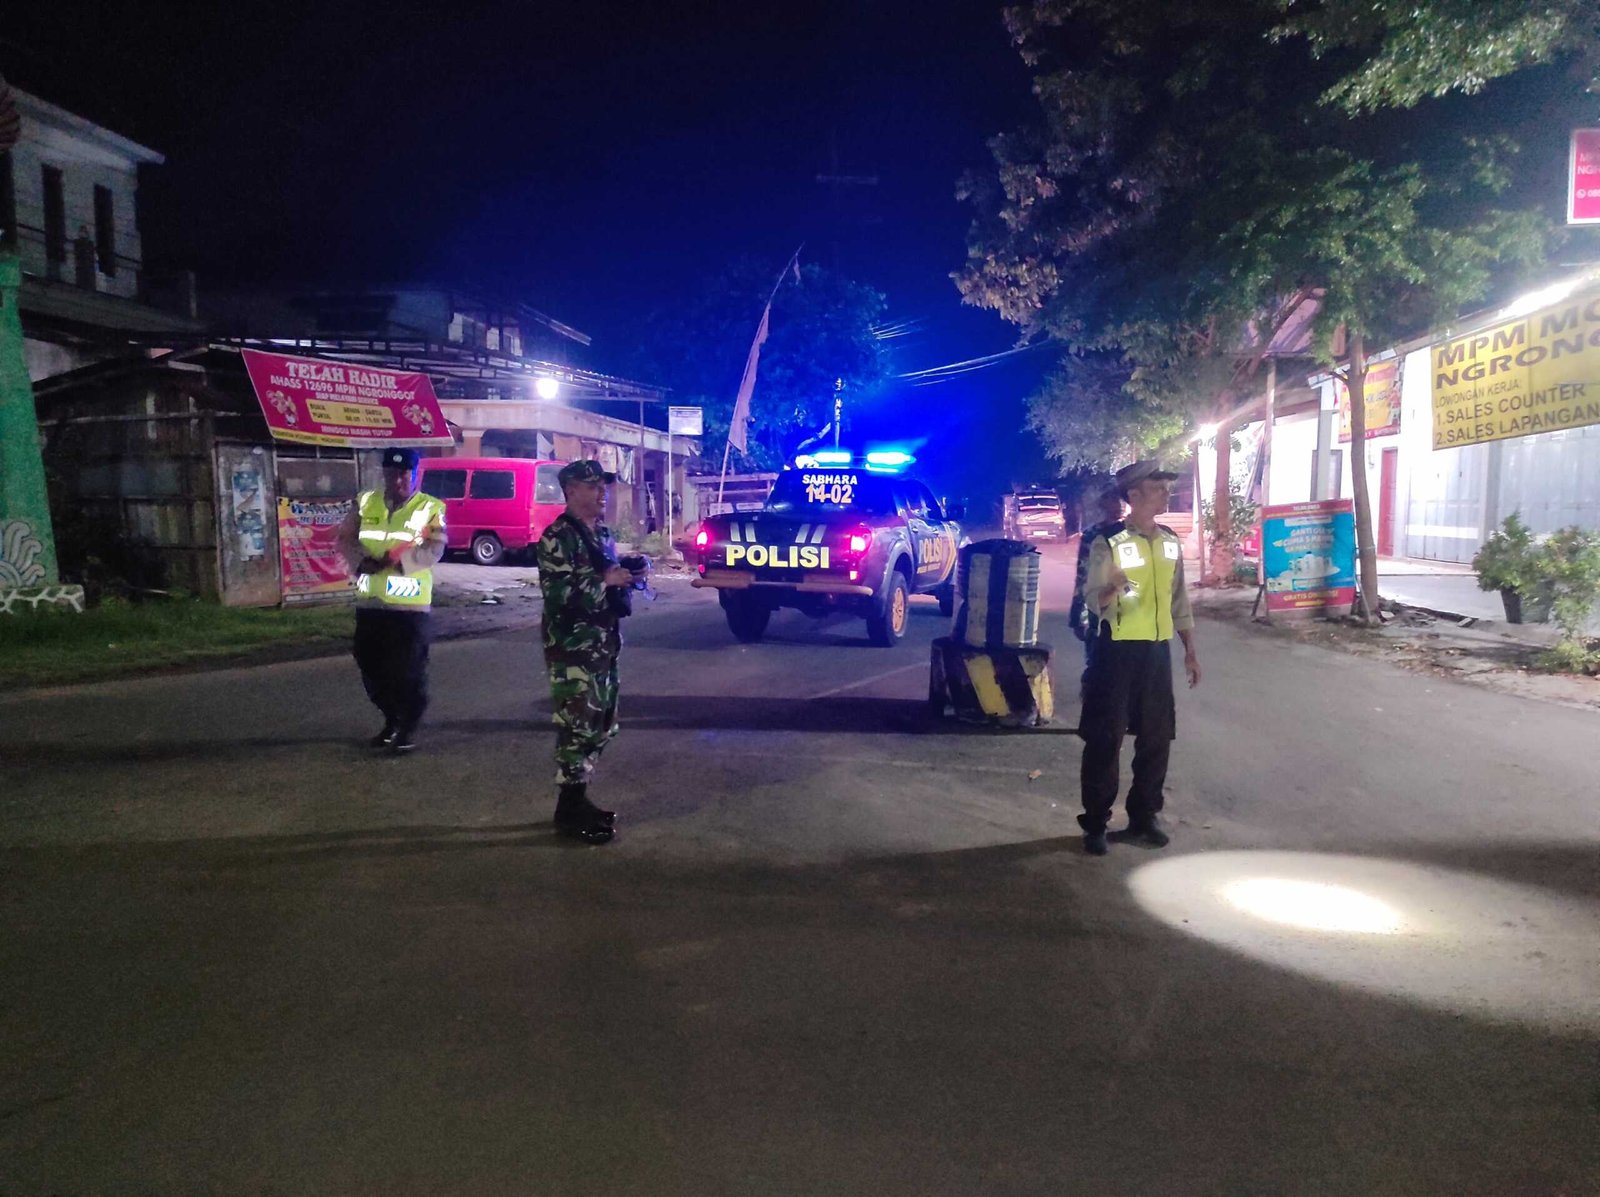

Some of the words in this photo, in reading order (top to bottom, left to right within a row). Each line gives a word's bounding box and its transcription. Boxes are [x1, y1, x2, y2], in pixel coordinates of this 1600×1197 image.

[1438, 324, 1525, 369] MPM
[270, 375, 302, 389] AHASS
[304, 380, 333, 392] 12696
[335, 384, 357, 395] MPM
[358, 387, 416, 400] NGRONGGOT
[285, 362, 345, 383] TELAH
[348, 369, 398, 389] HADIR
[1436, 389, 1484, 408] LOWONGAN
[1437, 402, 1493, 426] 1.SALES
[1498, 384, 1586, 413] COUNTER
[1436, 422, 1494, 445] 2.SALES
[1500, 402, 1600, 434] LAPANGAN
[802, 474, 858, 485] SABHARA
[806, 484, 853, 504] 14-02
[726, 544, 830, 569] POLISI
[919, 537, 942, 564] POLISI
